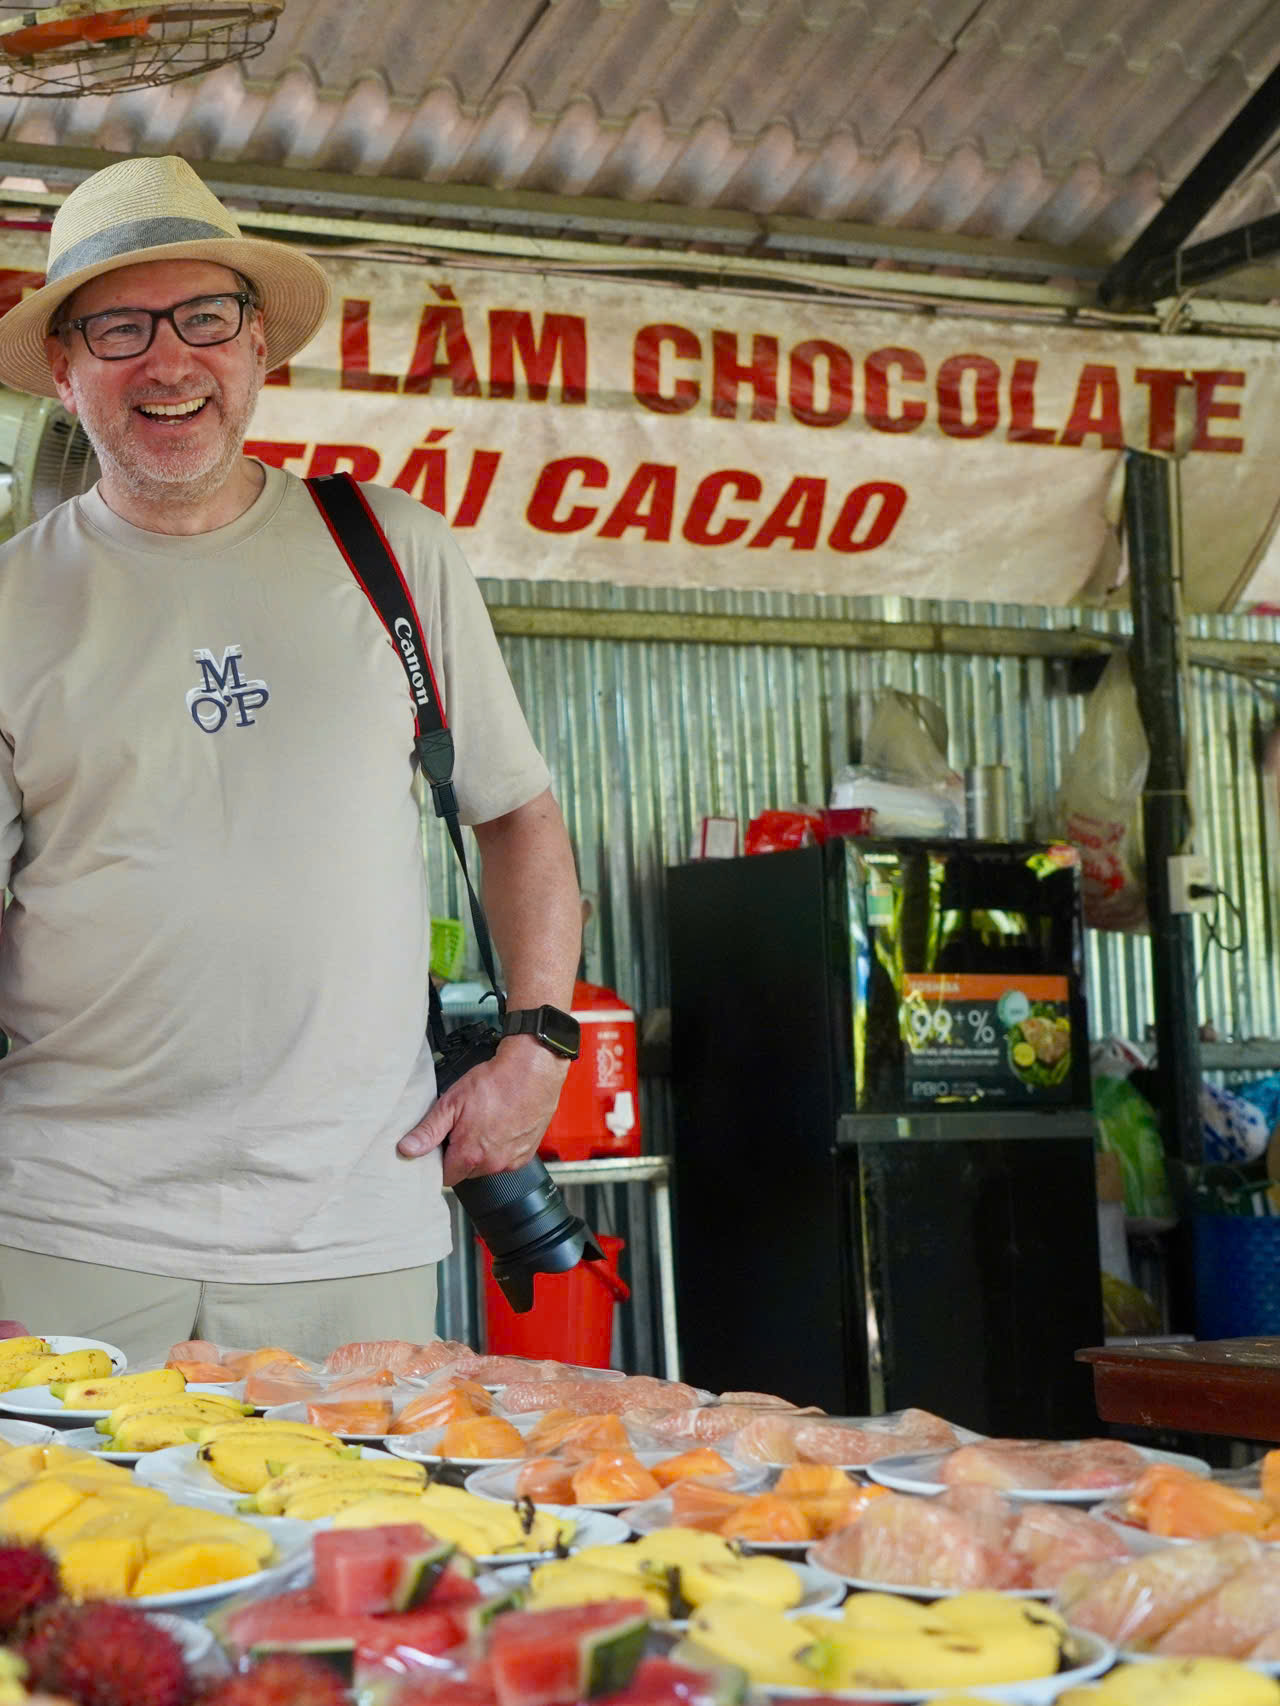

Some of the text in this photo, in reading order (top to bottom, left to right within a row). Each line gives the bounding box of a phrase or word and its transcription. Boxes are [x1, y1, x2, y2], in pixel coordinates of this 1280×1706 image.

[341, 283, 1247, 455] LÀM CHOCOLATE
[523, 454, 908, 556] CACAO
[193, 644, 248, 694] M
[393, 616, 430, 706] Canon
